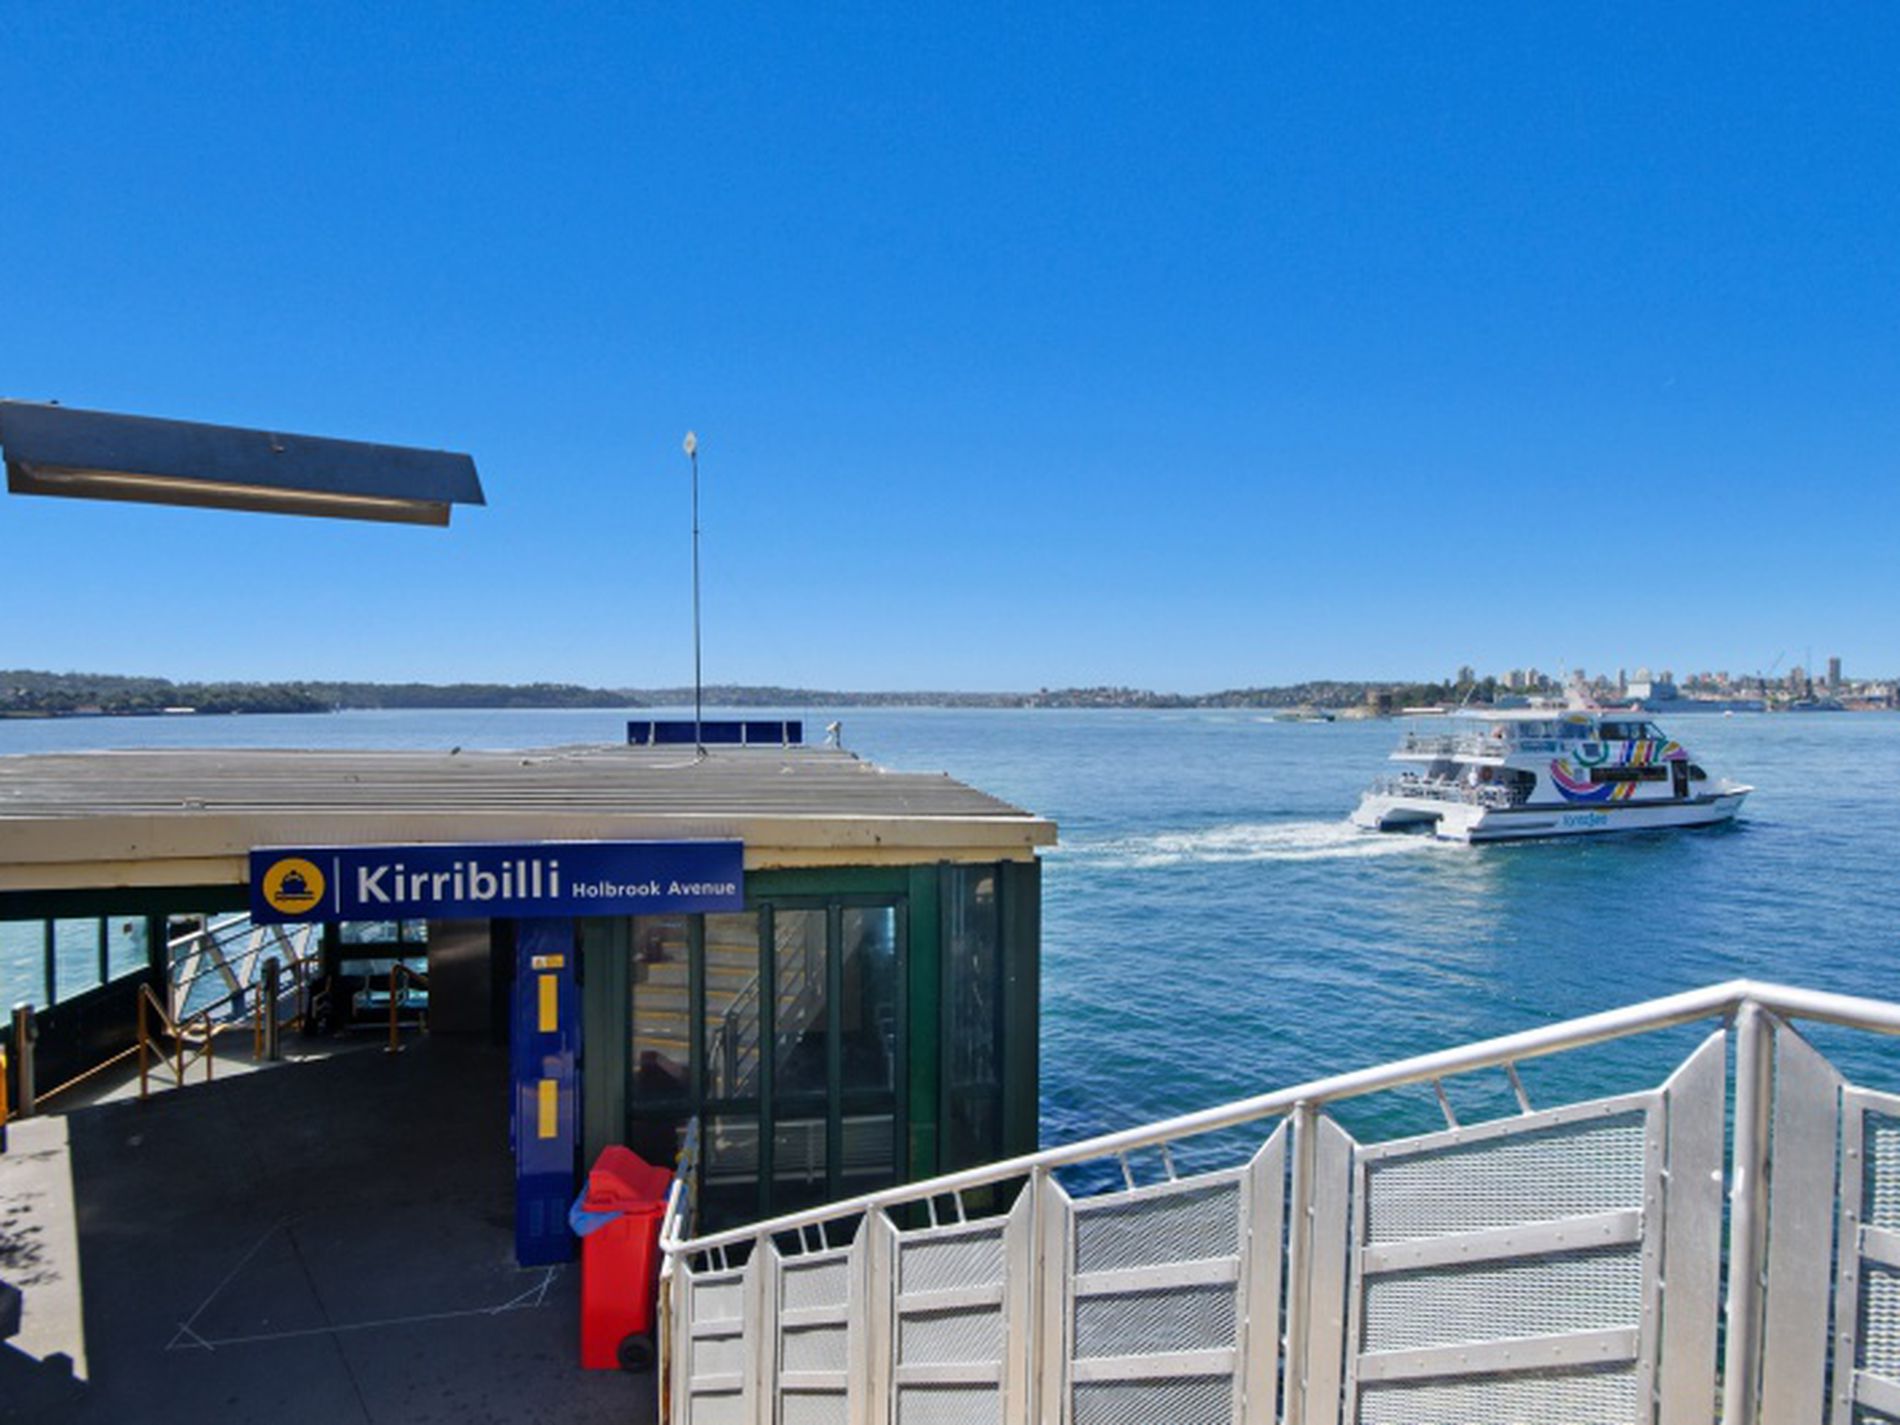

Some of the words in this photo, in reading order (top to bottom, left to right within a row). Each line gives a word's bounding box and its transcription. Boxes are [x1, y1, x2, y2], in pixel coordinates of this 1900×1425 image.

[358, 859, 559, 903] Kirribilli
[572, 880, 661, 898] Holbrook
[668, 881, 736, 897] Avenue
